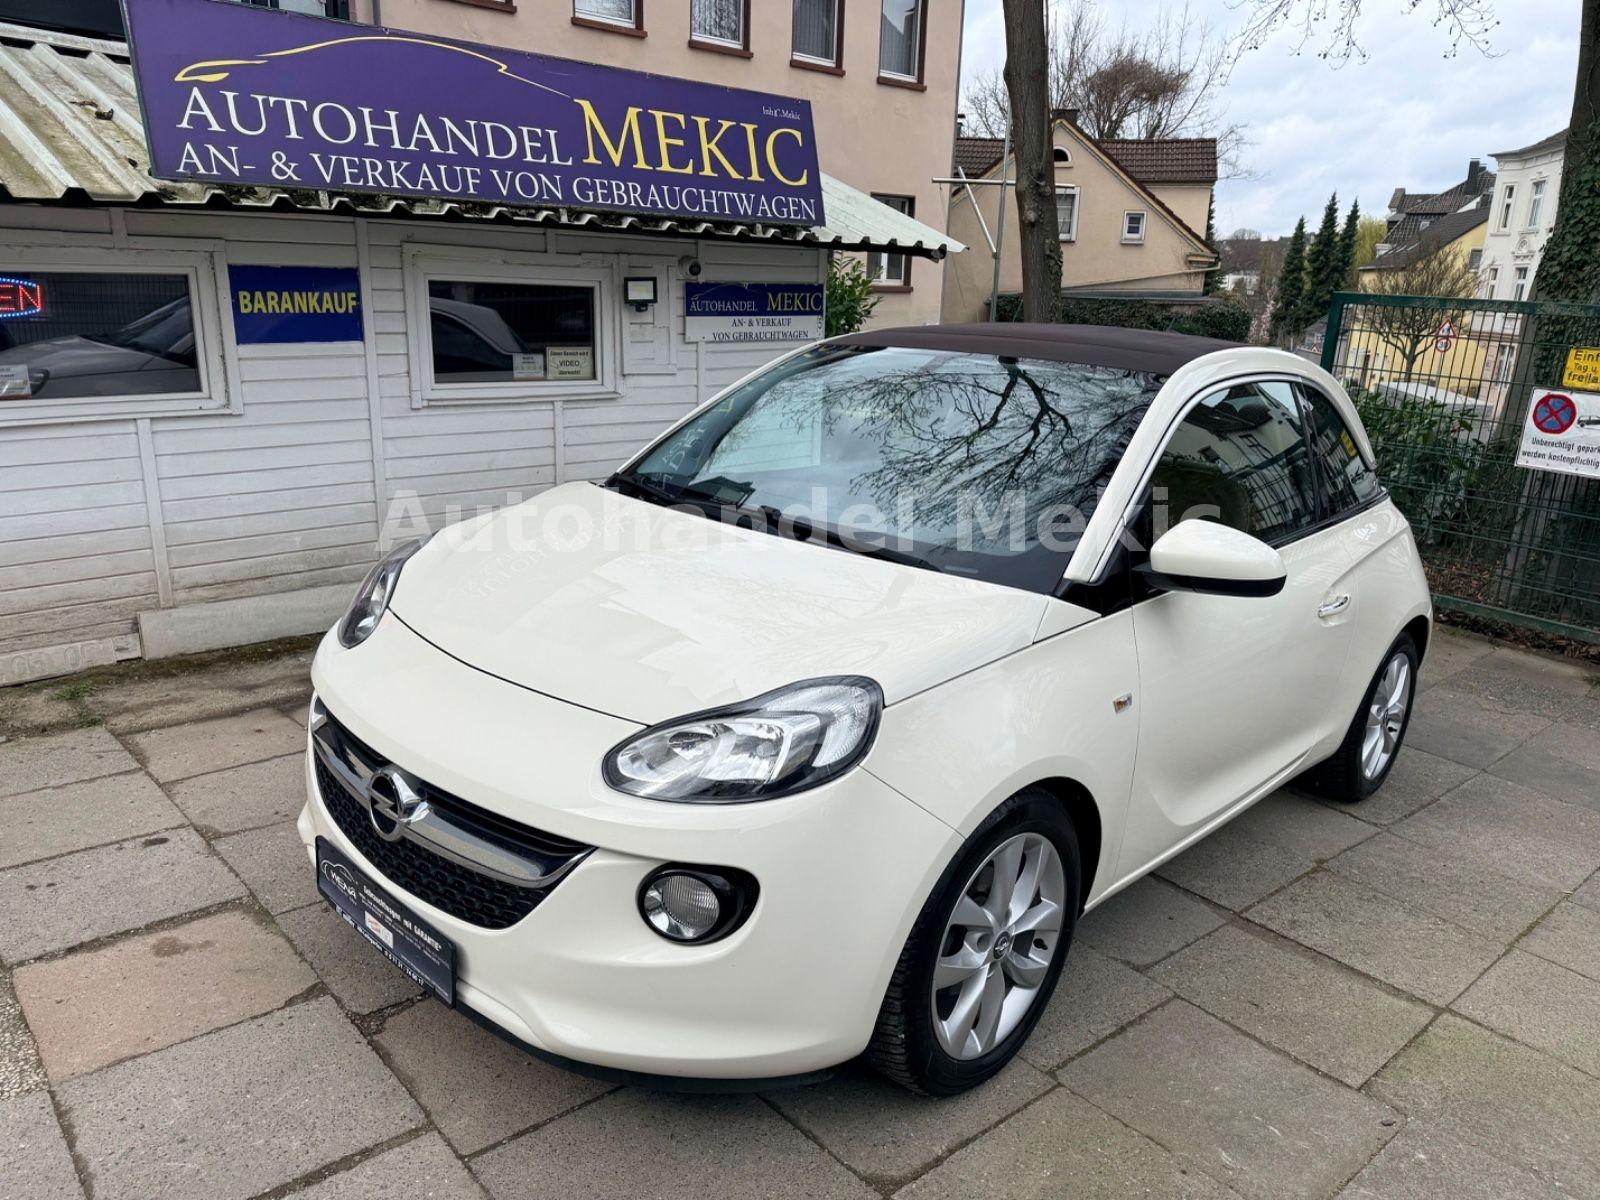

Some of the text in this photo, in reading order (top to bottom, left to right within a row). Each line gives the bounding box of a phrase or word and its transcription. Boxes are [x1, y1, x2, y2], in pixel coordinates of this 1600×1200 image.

[176, 86, 807, 186] AUTOHANDEL MEKIC
[176, 142, 817, 220] AN- & VERKAUF VON GEBRAUCHTWAGEN
[238, 290, 357, 315] BARANKAUF
[689, 292, 823, 312] AUTOHANDEL MEKIC
[731, 317, 792, 327] AN- & VERKAUF
[712, 330, 809, 341] VON GEBRAUCHTWAGEN
[558, 359, 580, 367] VIDEO
[1574, 362, 1589, 373] Tag
[1567, 371, 1600, 384] freila
[1531, 437, 1575, 452] Unberechtigt
[1522, 450, 1600, 469] werden kostenpflichtig
[335, 870, 357, 900] WENA
